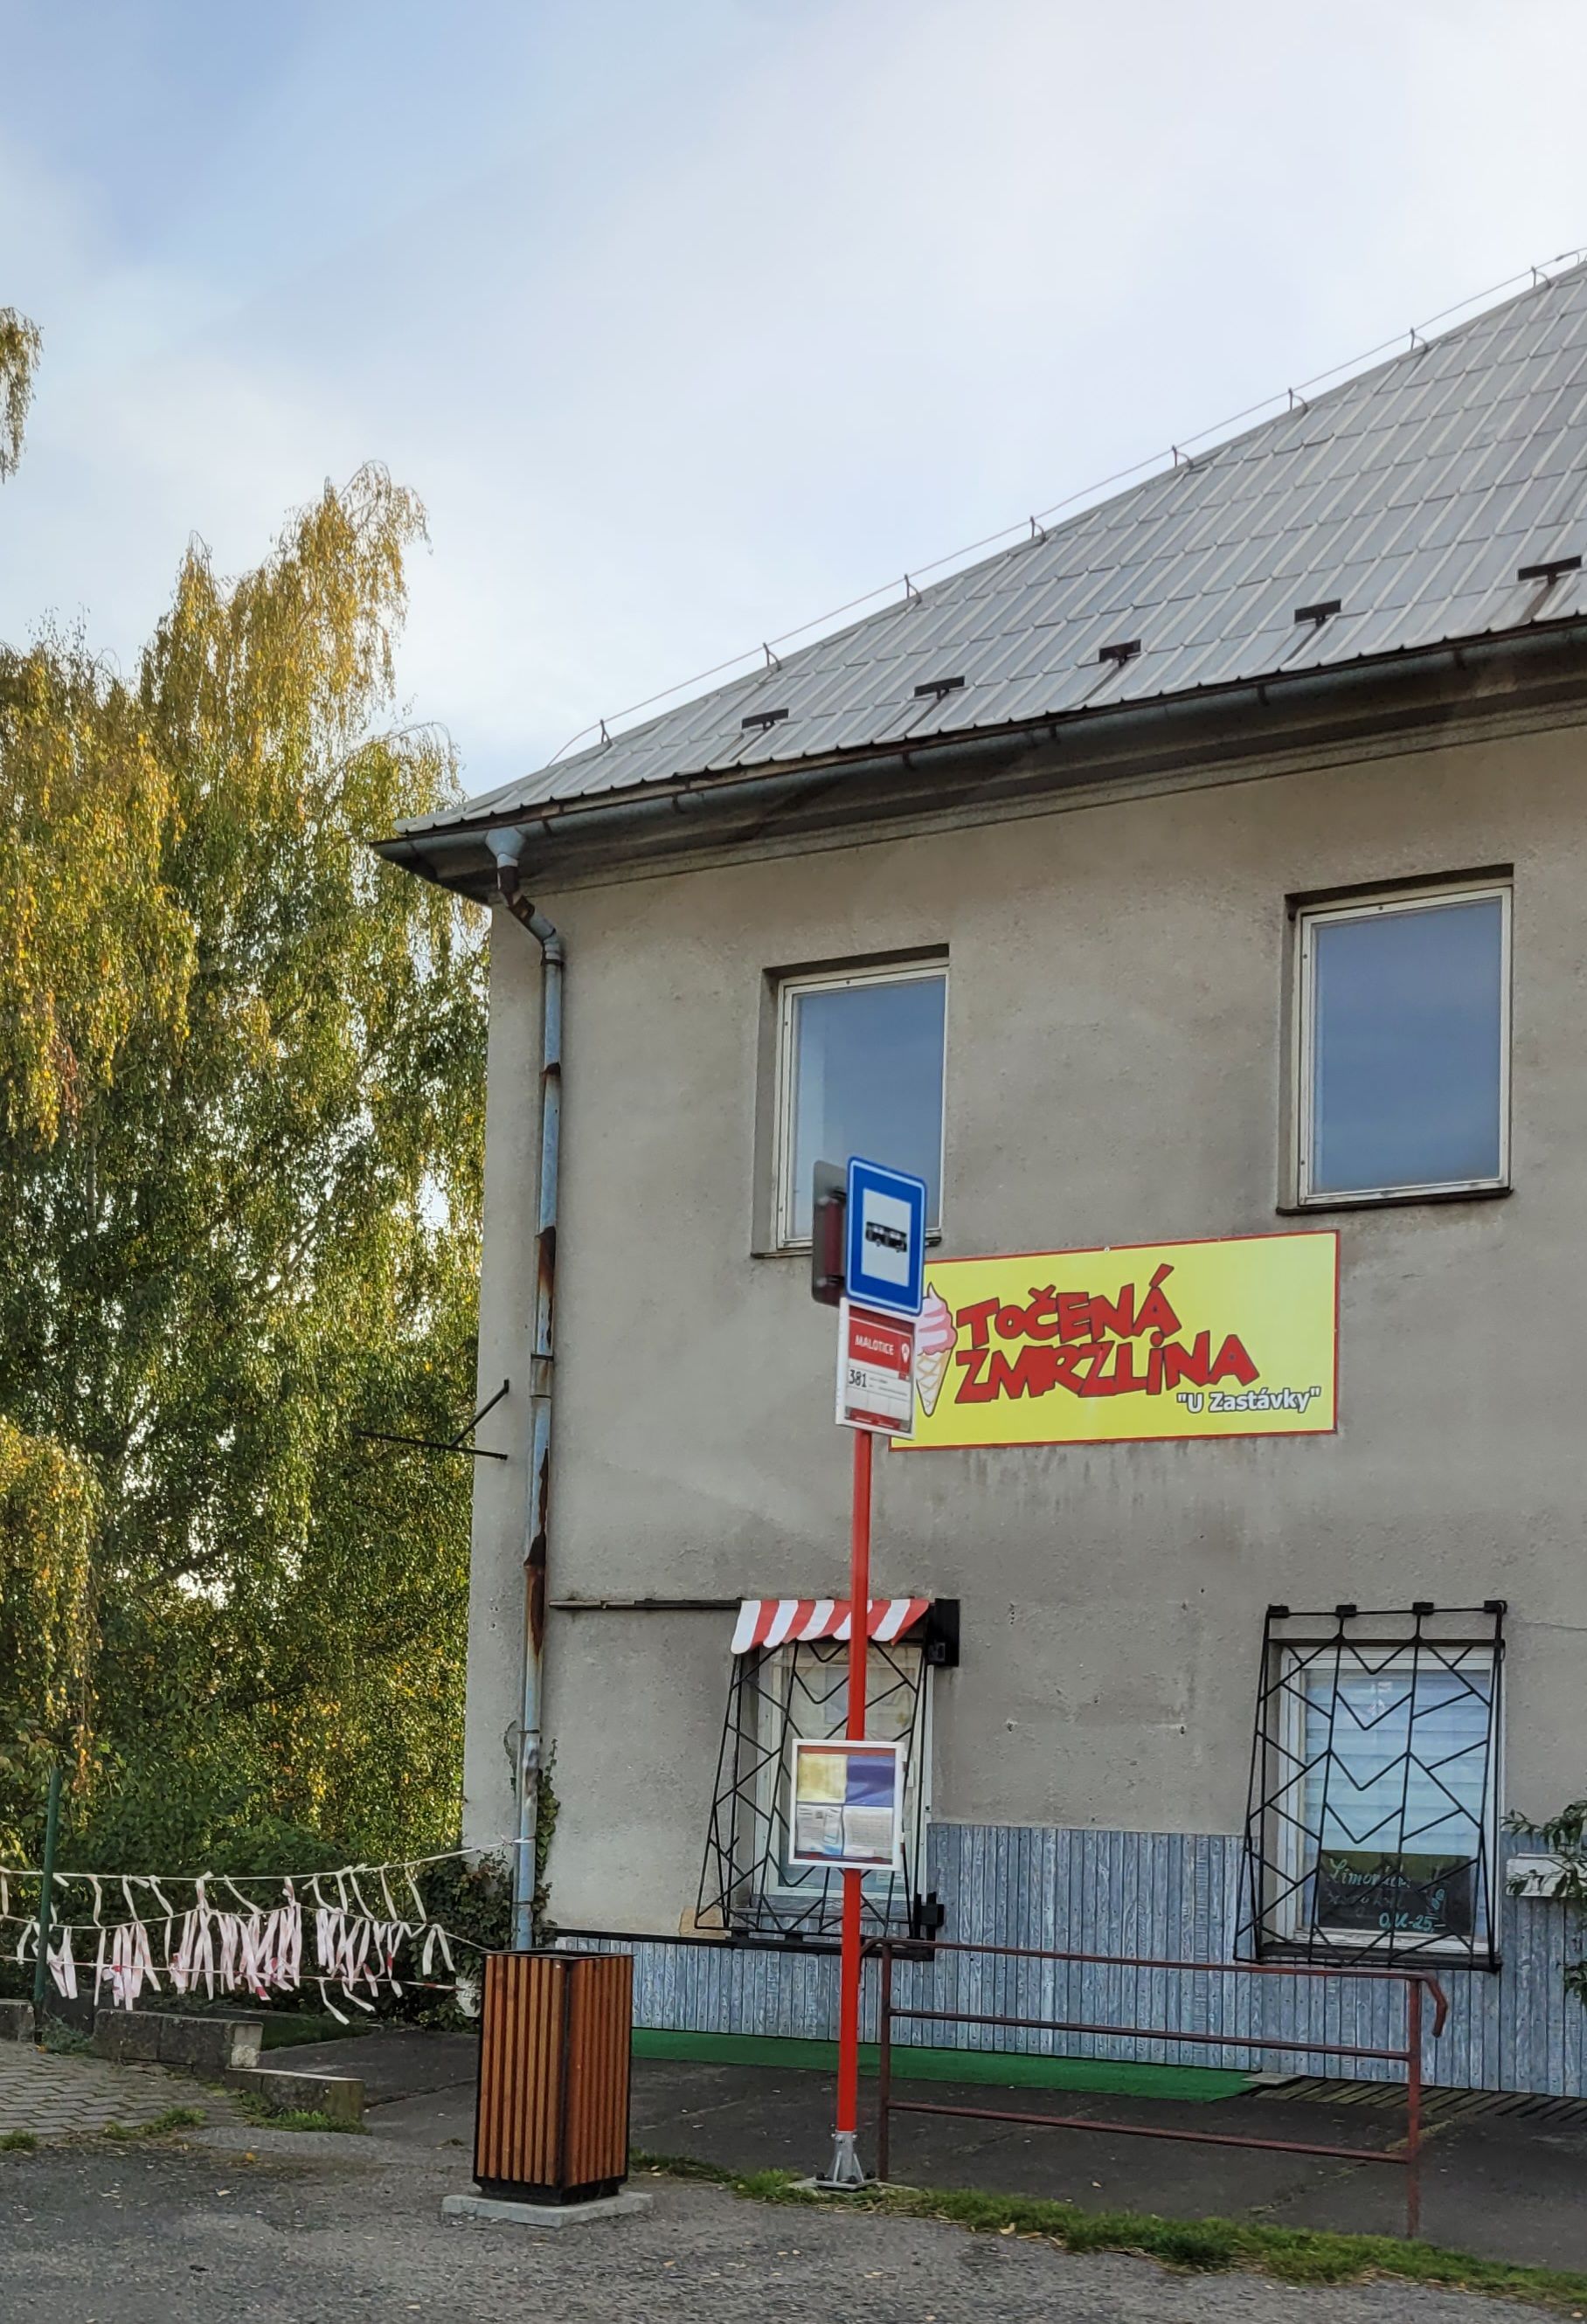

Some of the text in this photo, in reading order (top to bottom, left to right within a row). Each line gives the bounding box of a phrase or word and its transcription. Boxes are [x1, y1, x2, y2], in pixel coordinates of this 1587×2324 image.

[956, 1263, 1182, 1348] TOČENÁ
[855, 1334, 895, 1356] MALOTICE
[849, 1369, 867, 1387] 381
[1177, 1387, 1321, 1414] "U Zastávky"
